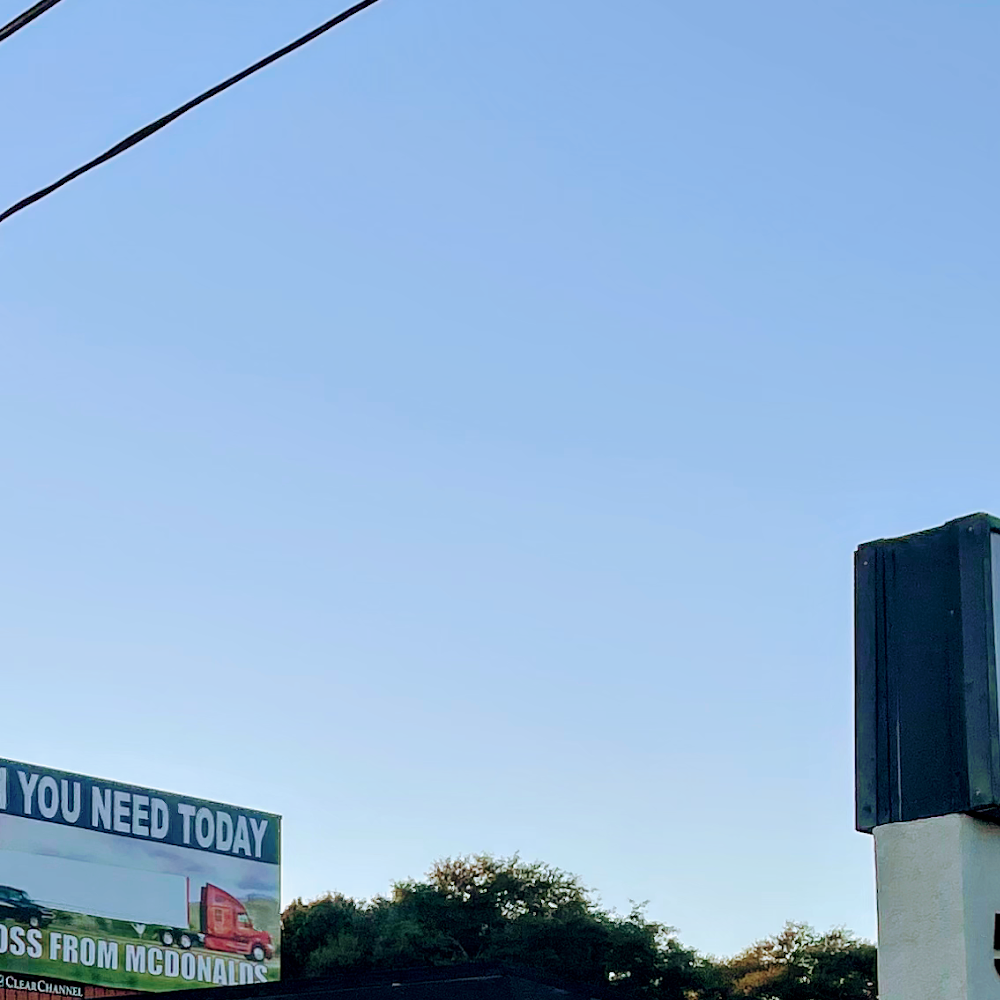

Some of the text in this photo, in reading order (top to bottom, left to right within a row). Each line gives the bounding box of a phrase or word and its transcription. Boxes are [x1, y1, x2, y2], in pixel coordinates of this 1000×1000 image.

[17, 770, 81, 823] YOU
[91, 785, 169, 840] NEED
[177, 803, 268, 858] TODAY
[50, 931, 118, 970] FROM
[125, 944, 268, 986] MCDONALDS
